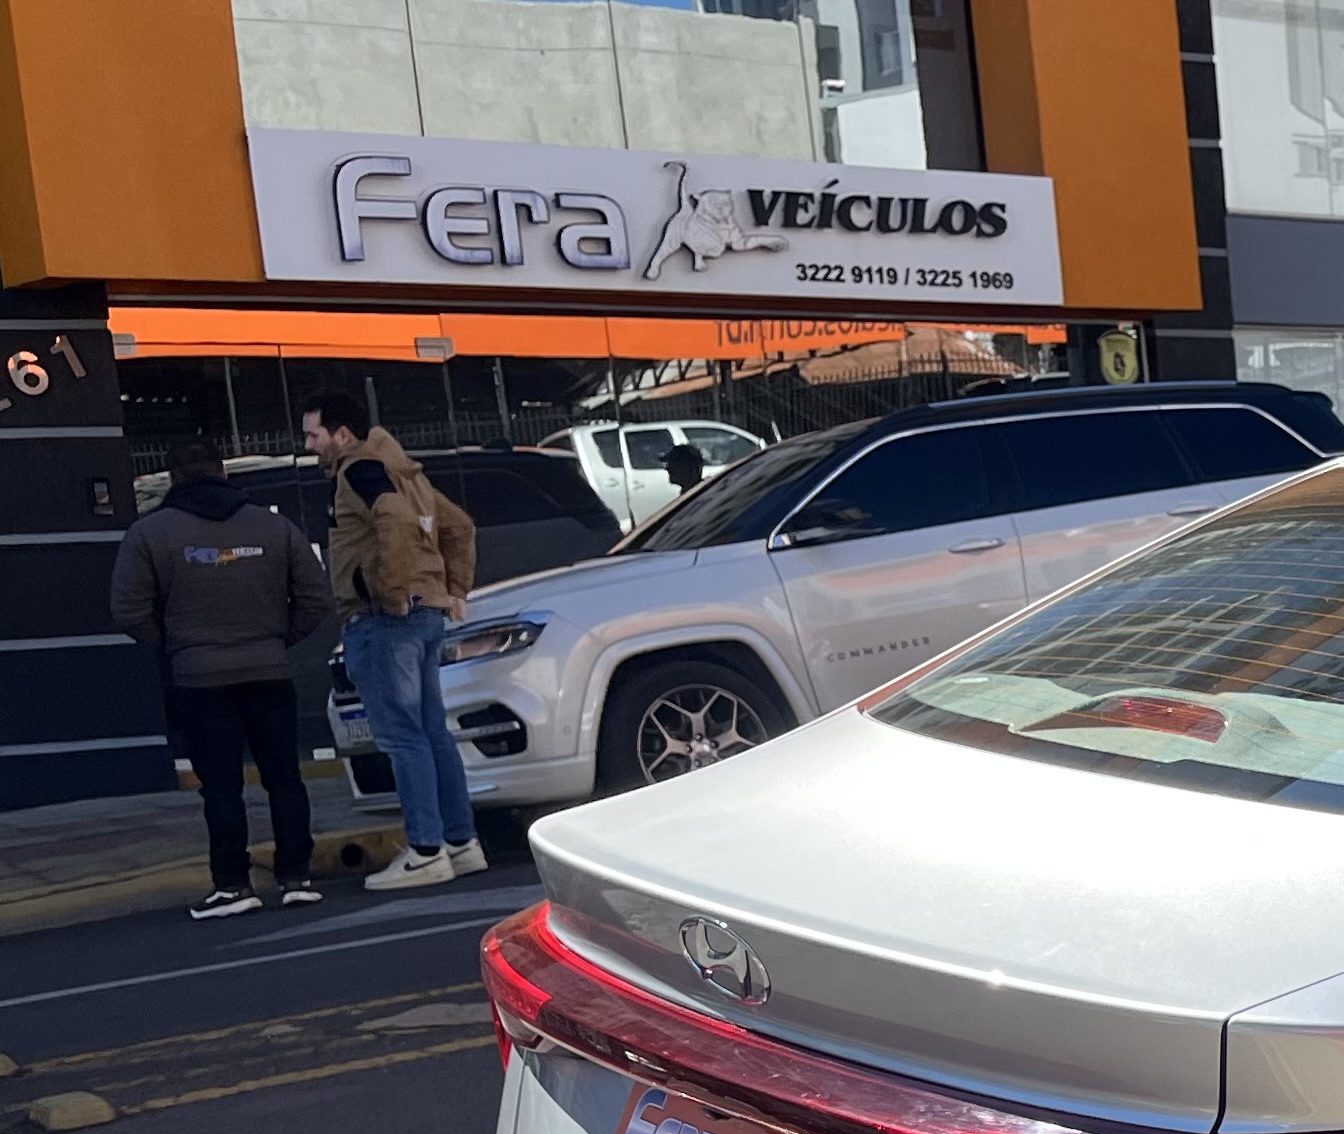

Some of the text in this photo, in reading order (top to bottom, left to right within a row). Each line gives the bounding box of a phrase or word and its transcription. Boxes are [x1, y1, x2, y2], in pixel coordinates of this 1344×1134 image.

[332, 155, 631, 270] Fera
[747, 178, 1009, 239] VEÍCULOS
[795, 263, 1014, 290] 3222 9119 / 3225 1969
[826, 636, 930, 663] COMMANDER
